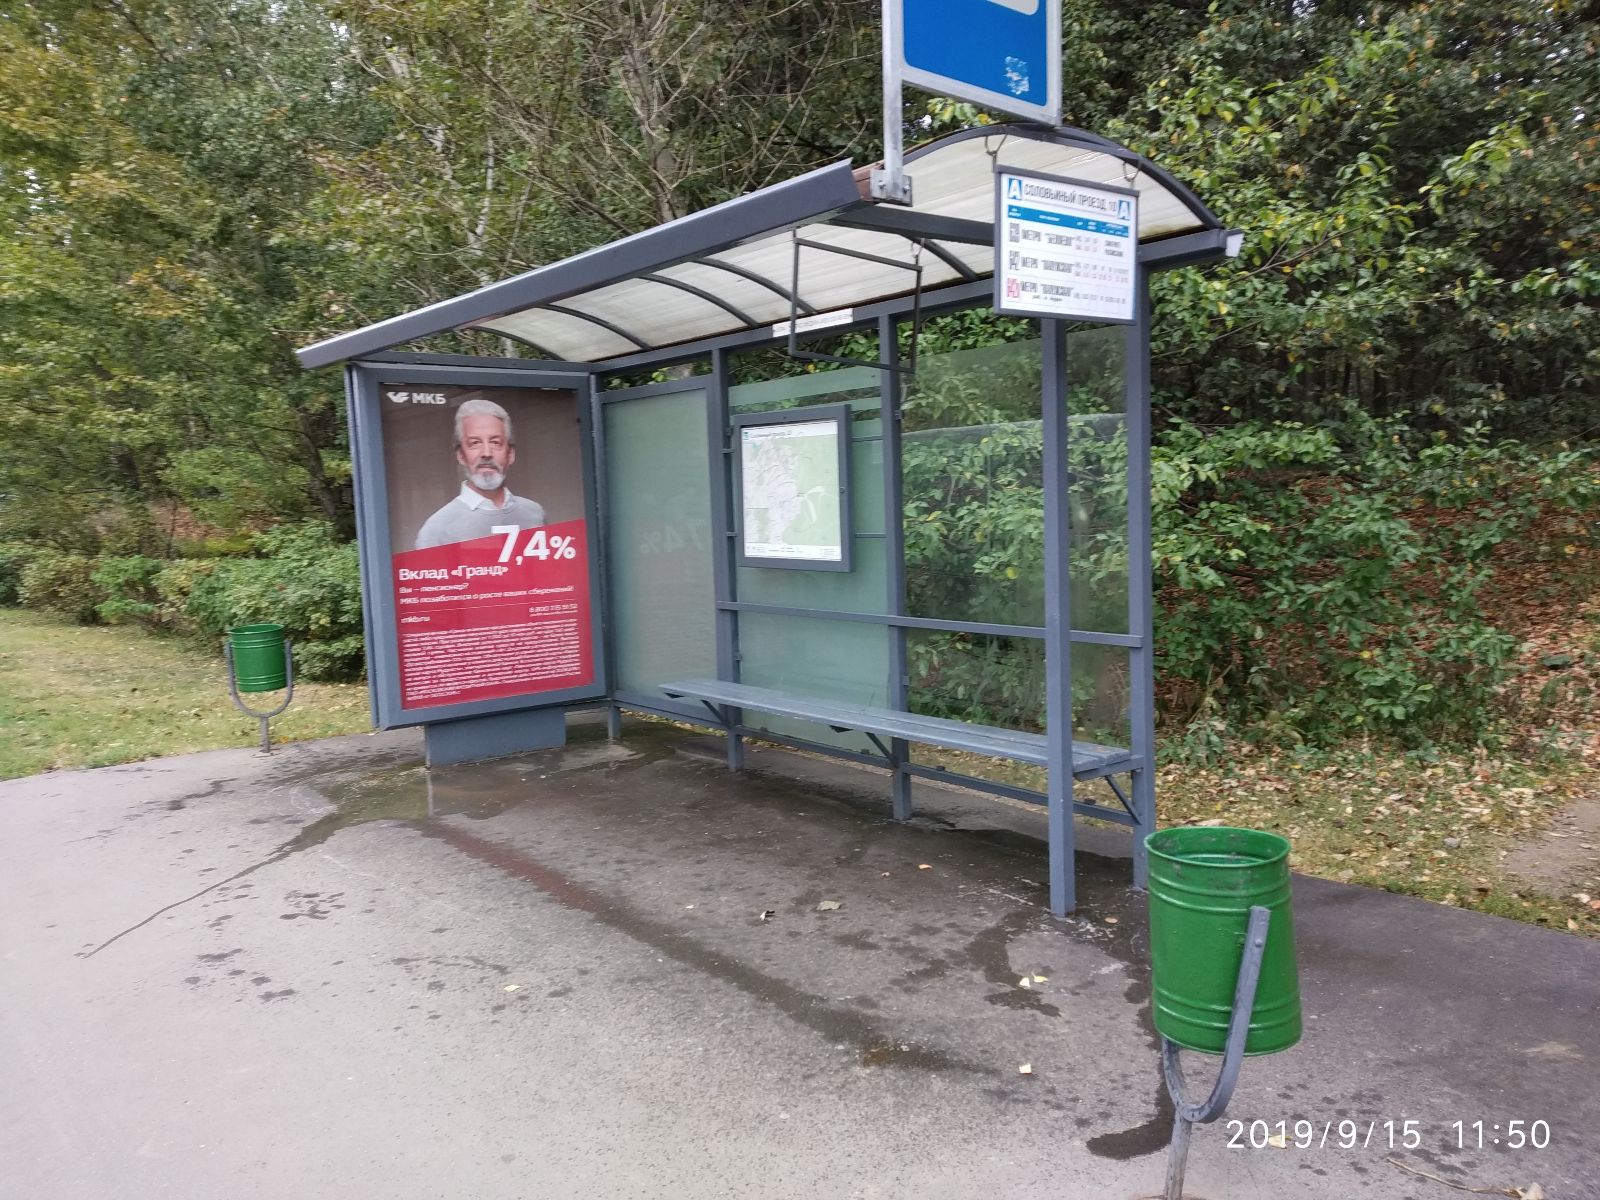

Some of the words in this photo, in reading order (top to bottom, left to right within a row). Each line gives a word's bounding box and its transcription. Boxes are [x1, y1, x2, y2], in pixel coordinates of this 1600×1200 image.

[1024, 183, 1076, 204] СОЛОВЬИНЫЙ
[411, 392, 447, 404] МКБ
[491, 524, 576, 566] 7,4%
[399, 568, 449, 580] Вклад
[450, 565, 509, 579] «Гранд»
